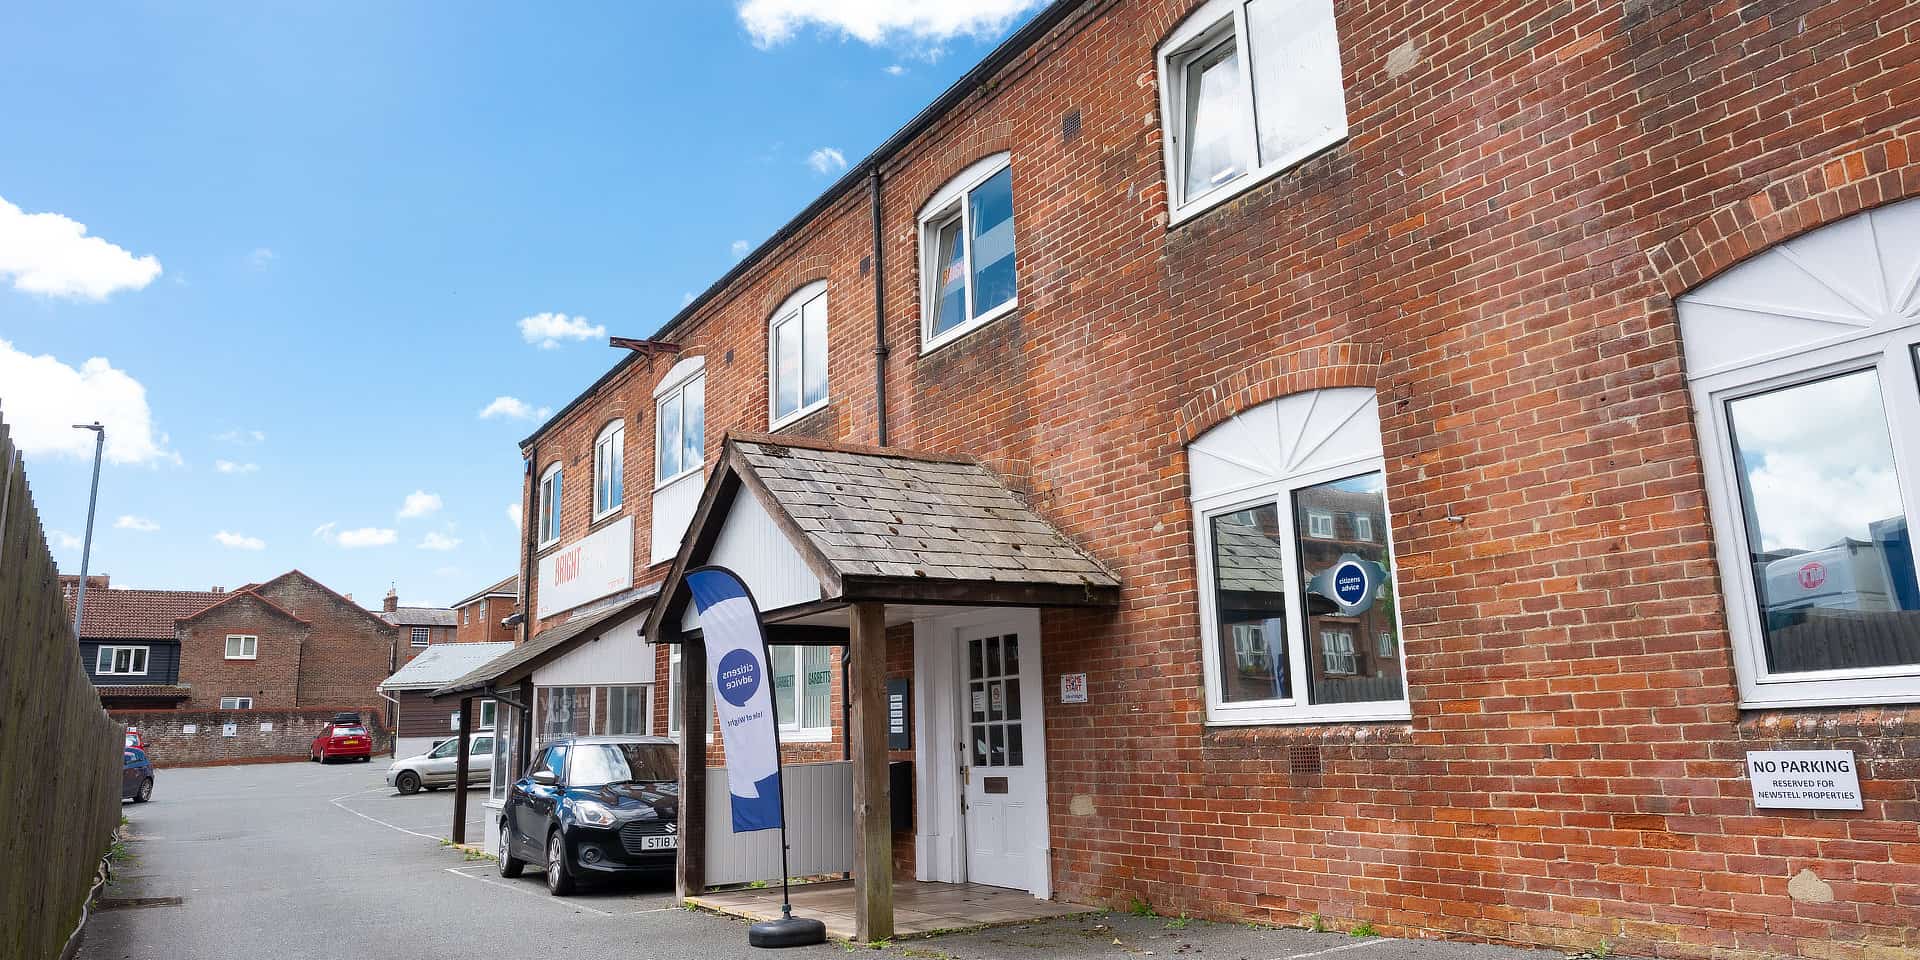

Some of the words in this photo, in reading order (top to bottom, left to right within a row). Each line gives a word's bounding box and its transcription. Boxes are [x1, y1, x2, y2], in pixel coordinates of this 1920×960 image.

[554, 546, 582, 587] BRIGHT
[1339, 576, 1361, 585] citizens
[1341, 584, 1360, 592] advice
[1753, 760, 1776, 773] NO
[1781, 760, 1850, 773] PARKING
[1772, 779, 1815, 788] RESERVED
[1817, 779, 1835, 788] FOR
[1758, 791, 1800, 799] NEWSTELL
[1802, 791, 1855, 800] PROPERTIES
[648, 837, 670, 848] ST18
